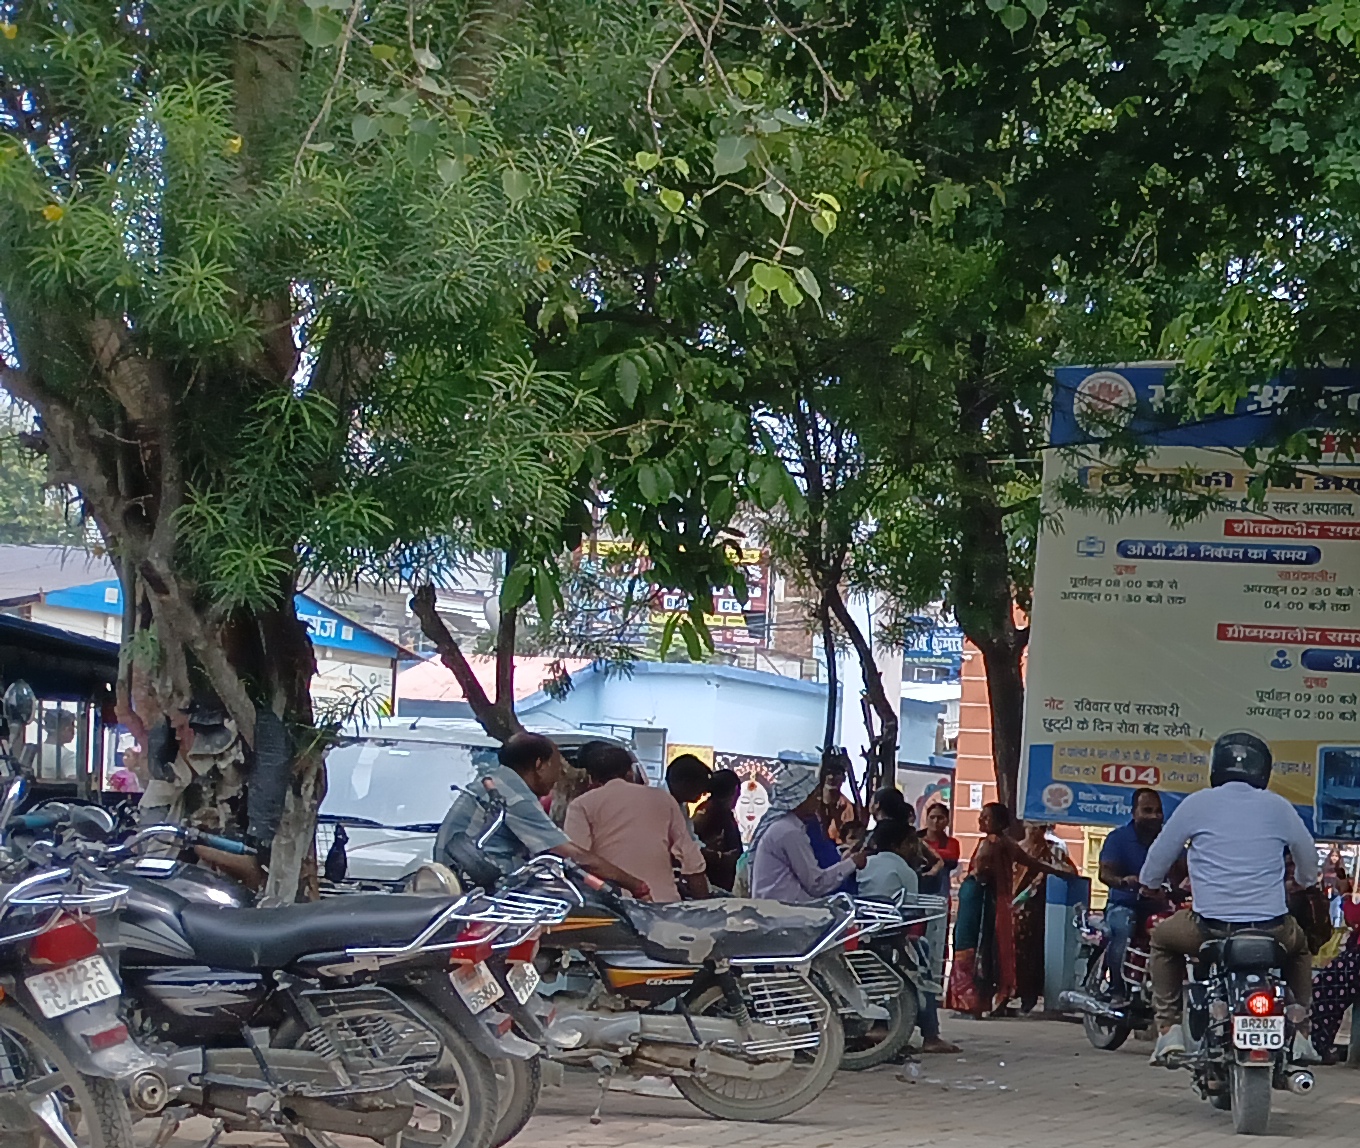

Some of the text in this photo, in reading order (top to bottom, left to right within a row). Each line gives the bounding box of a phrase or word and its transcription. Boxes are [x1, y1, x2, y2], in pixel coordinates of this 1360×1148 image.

[1272, 502, 1299, 516] सदर
[1044, 697, 1064, 710] नोट
[1074, 698, 1111, 713] रविवार
[1135, 703, 1180, 717] सरकारी
[1077, 717, 1089, 731] के
[1093, 718, 1112, 732] दिन
[1104, 765, 1157, 784] 104
